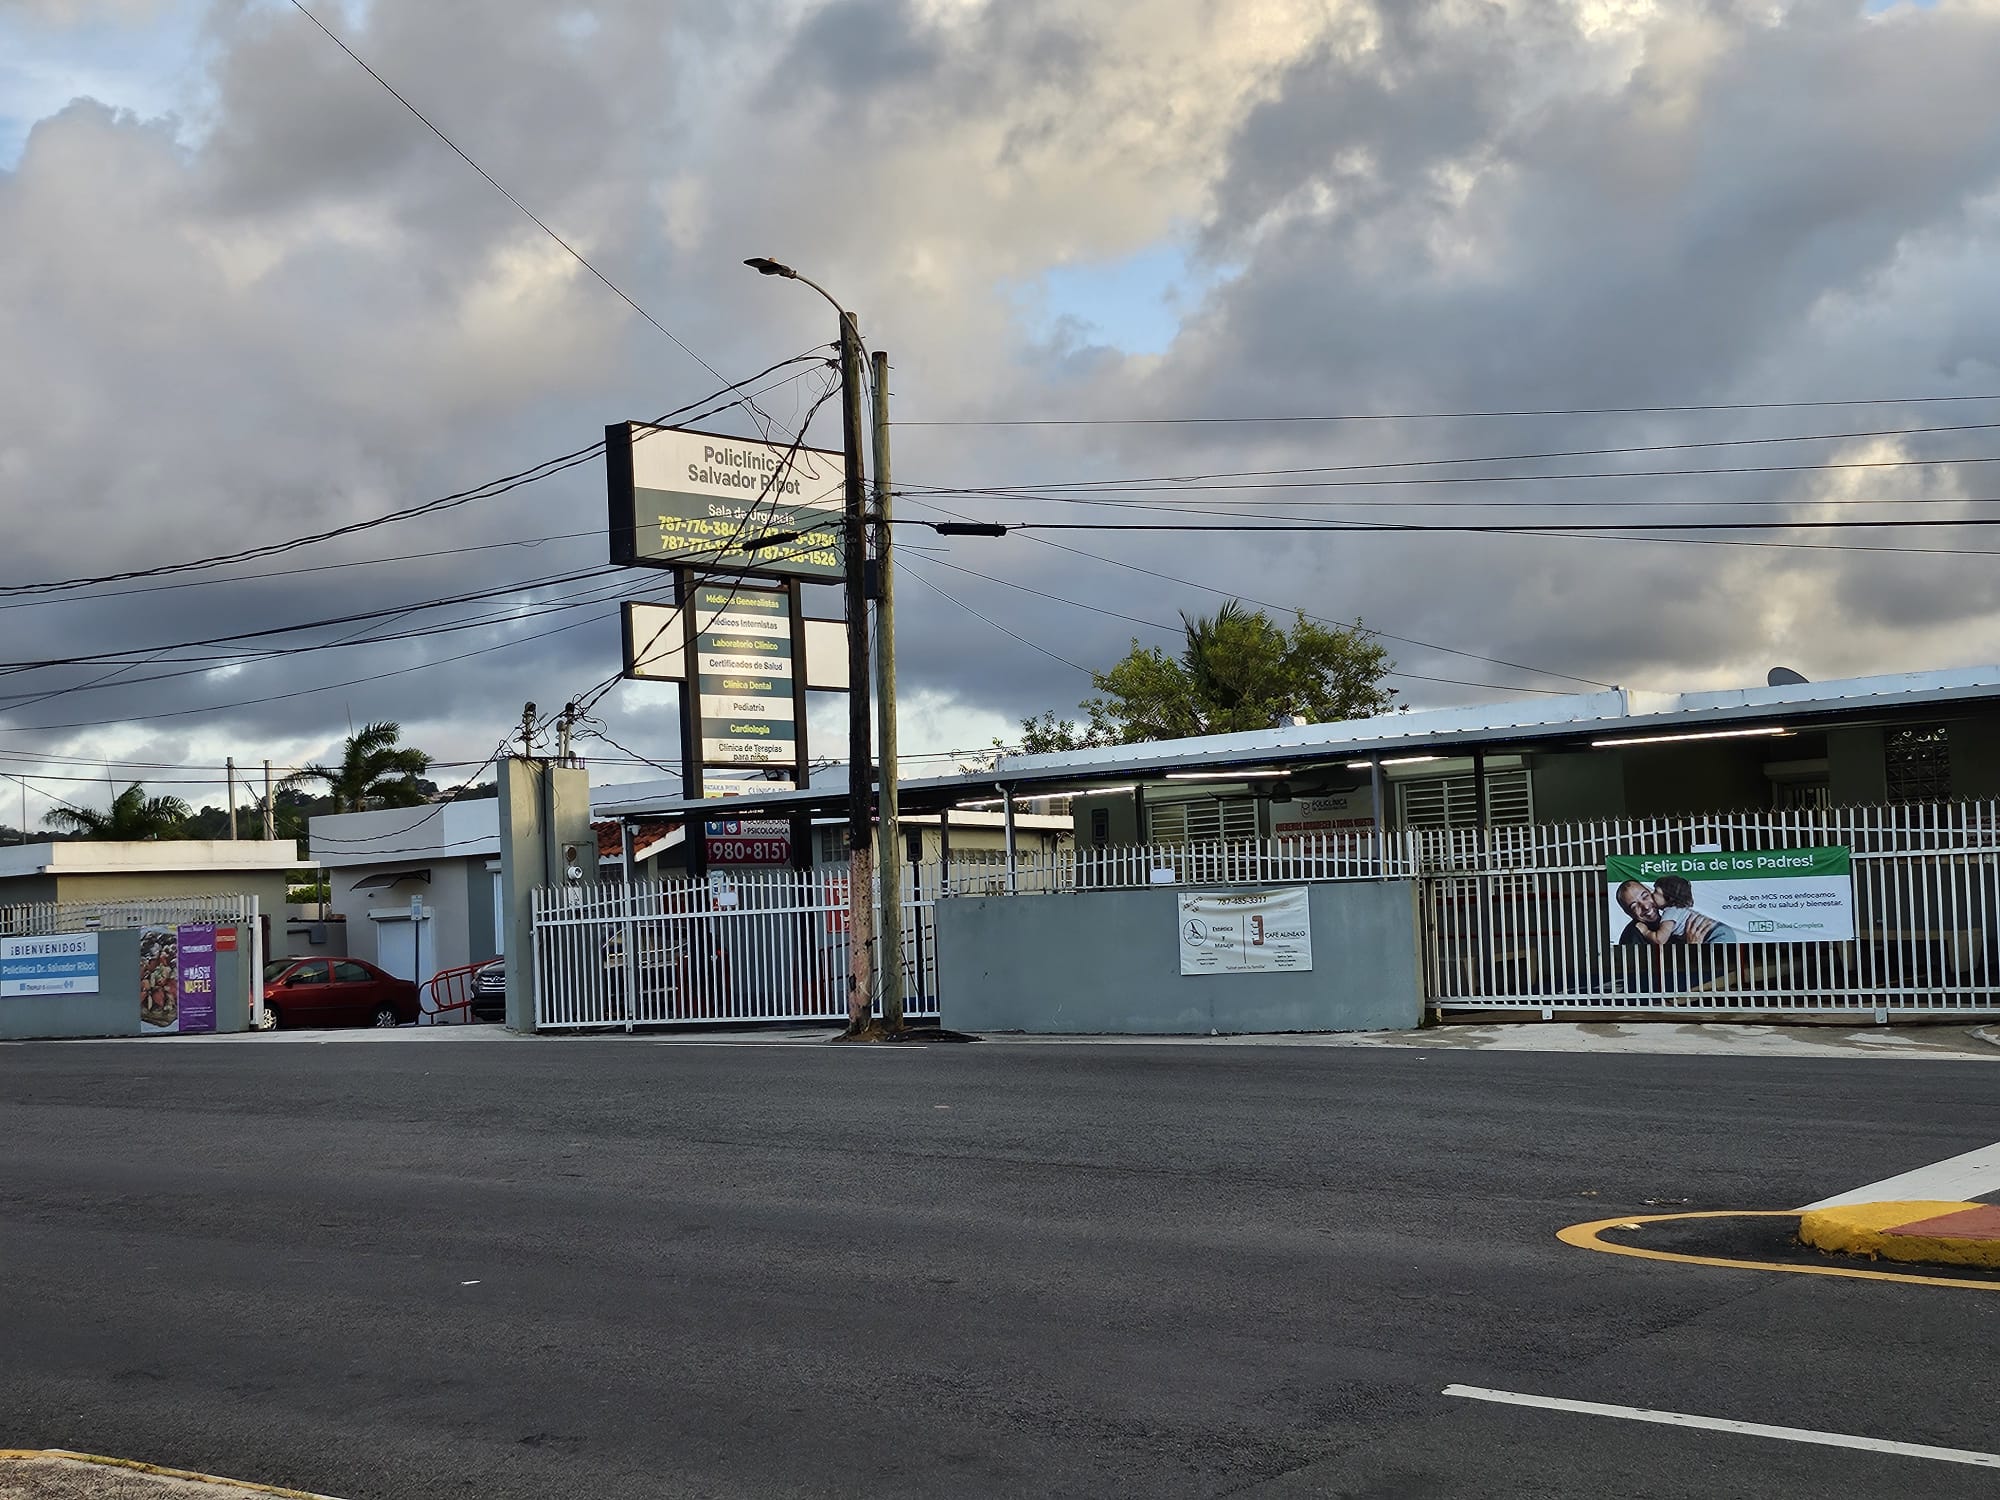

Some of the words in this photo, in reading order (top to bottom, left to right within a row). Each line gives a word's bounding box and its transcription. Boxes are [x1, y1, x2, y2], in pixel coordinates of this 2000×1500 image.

[704, 446, 784, 472] Policlínica
[688, 463, 756, 489] Salvador
[760, 474, 801, 495] Ribot
[708, 504, 732, 518] Sala
[734, 506, 750, 520] de
[750, 509, 795, 526] Urgencia
[706, 594, 736, 605] Médics
[736, 597, 779, 609] Generalistas
[740, 619, 778, 630] Internistas
[712, 638, 753, 649] Laboratorio
[709, 659, 752, 669] Certificados
[754, 661, 763, 670] de
[764, 661, 783, 671] Salud
[749, 681, 772, 691] Dental
[744, 744, 753, 752] de
[754, 744, 782, 754] Terapias
[733, 754, 750, 762] para
[750, 753, 769, 761] niños
[1641, 860, 1677, 875] ¡Feliz
[1682, 858, 1705, 872] Día
[1710, 858, 1728, 870] de
[1733, 857, 1754, 869] los
[1758, 855, 1814, 869] Padres!
[1733, 901, 1755, 910] cuidar
[1778, 900, 1798, 908] salud
[1749, 921, 1773, 932] MCS
[1793, 922, 1824, 930] Completa
[11, 941, 86, 956] ¡BIENVENIDOS!
[47, 962, 76, 973] Salvador
[77, 961, 96, 971] Ribot
[184, 979, 212, 994] WAFFLE
